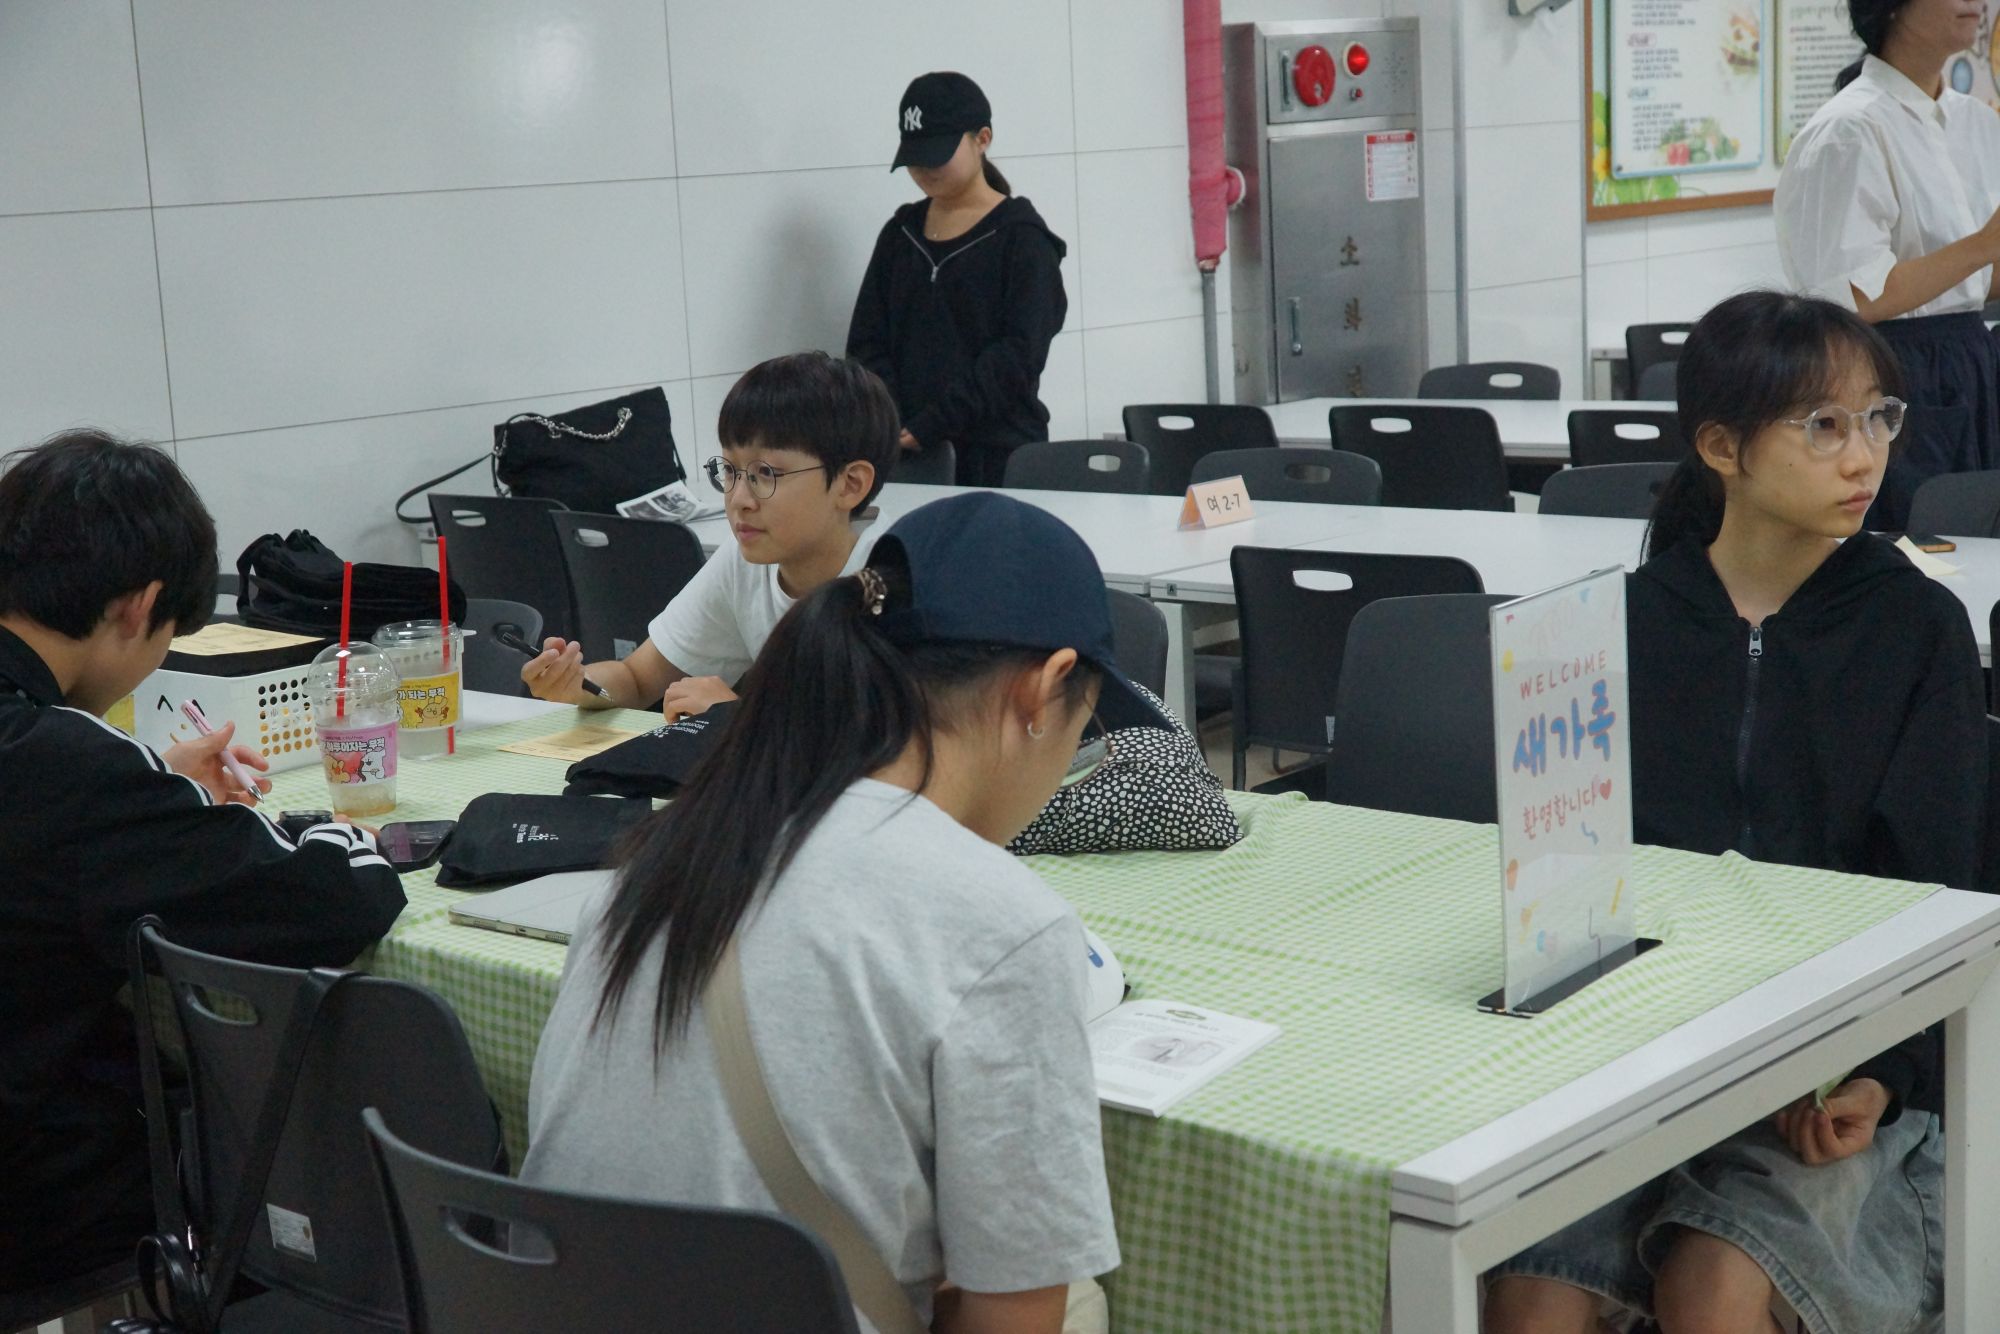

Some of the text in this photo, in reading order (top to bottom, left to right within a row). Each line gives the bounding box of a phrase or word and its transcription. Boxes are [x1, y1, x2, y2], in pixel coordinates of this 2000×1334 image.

[1207, 495, 1222, 514] 여
[1520, 650, 1607, 700] WELCOME
[1513, 679, 1616, 778] 새가족
[1523, 780, 1598, 840] 환영합니다
